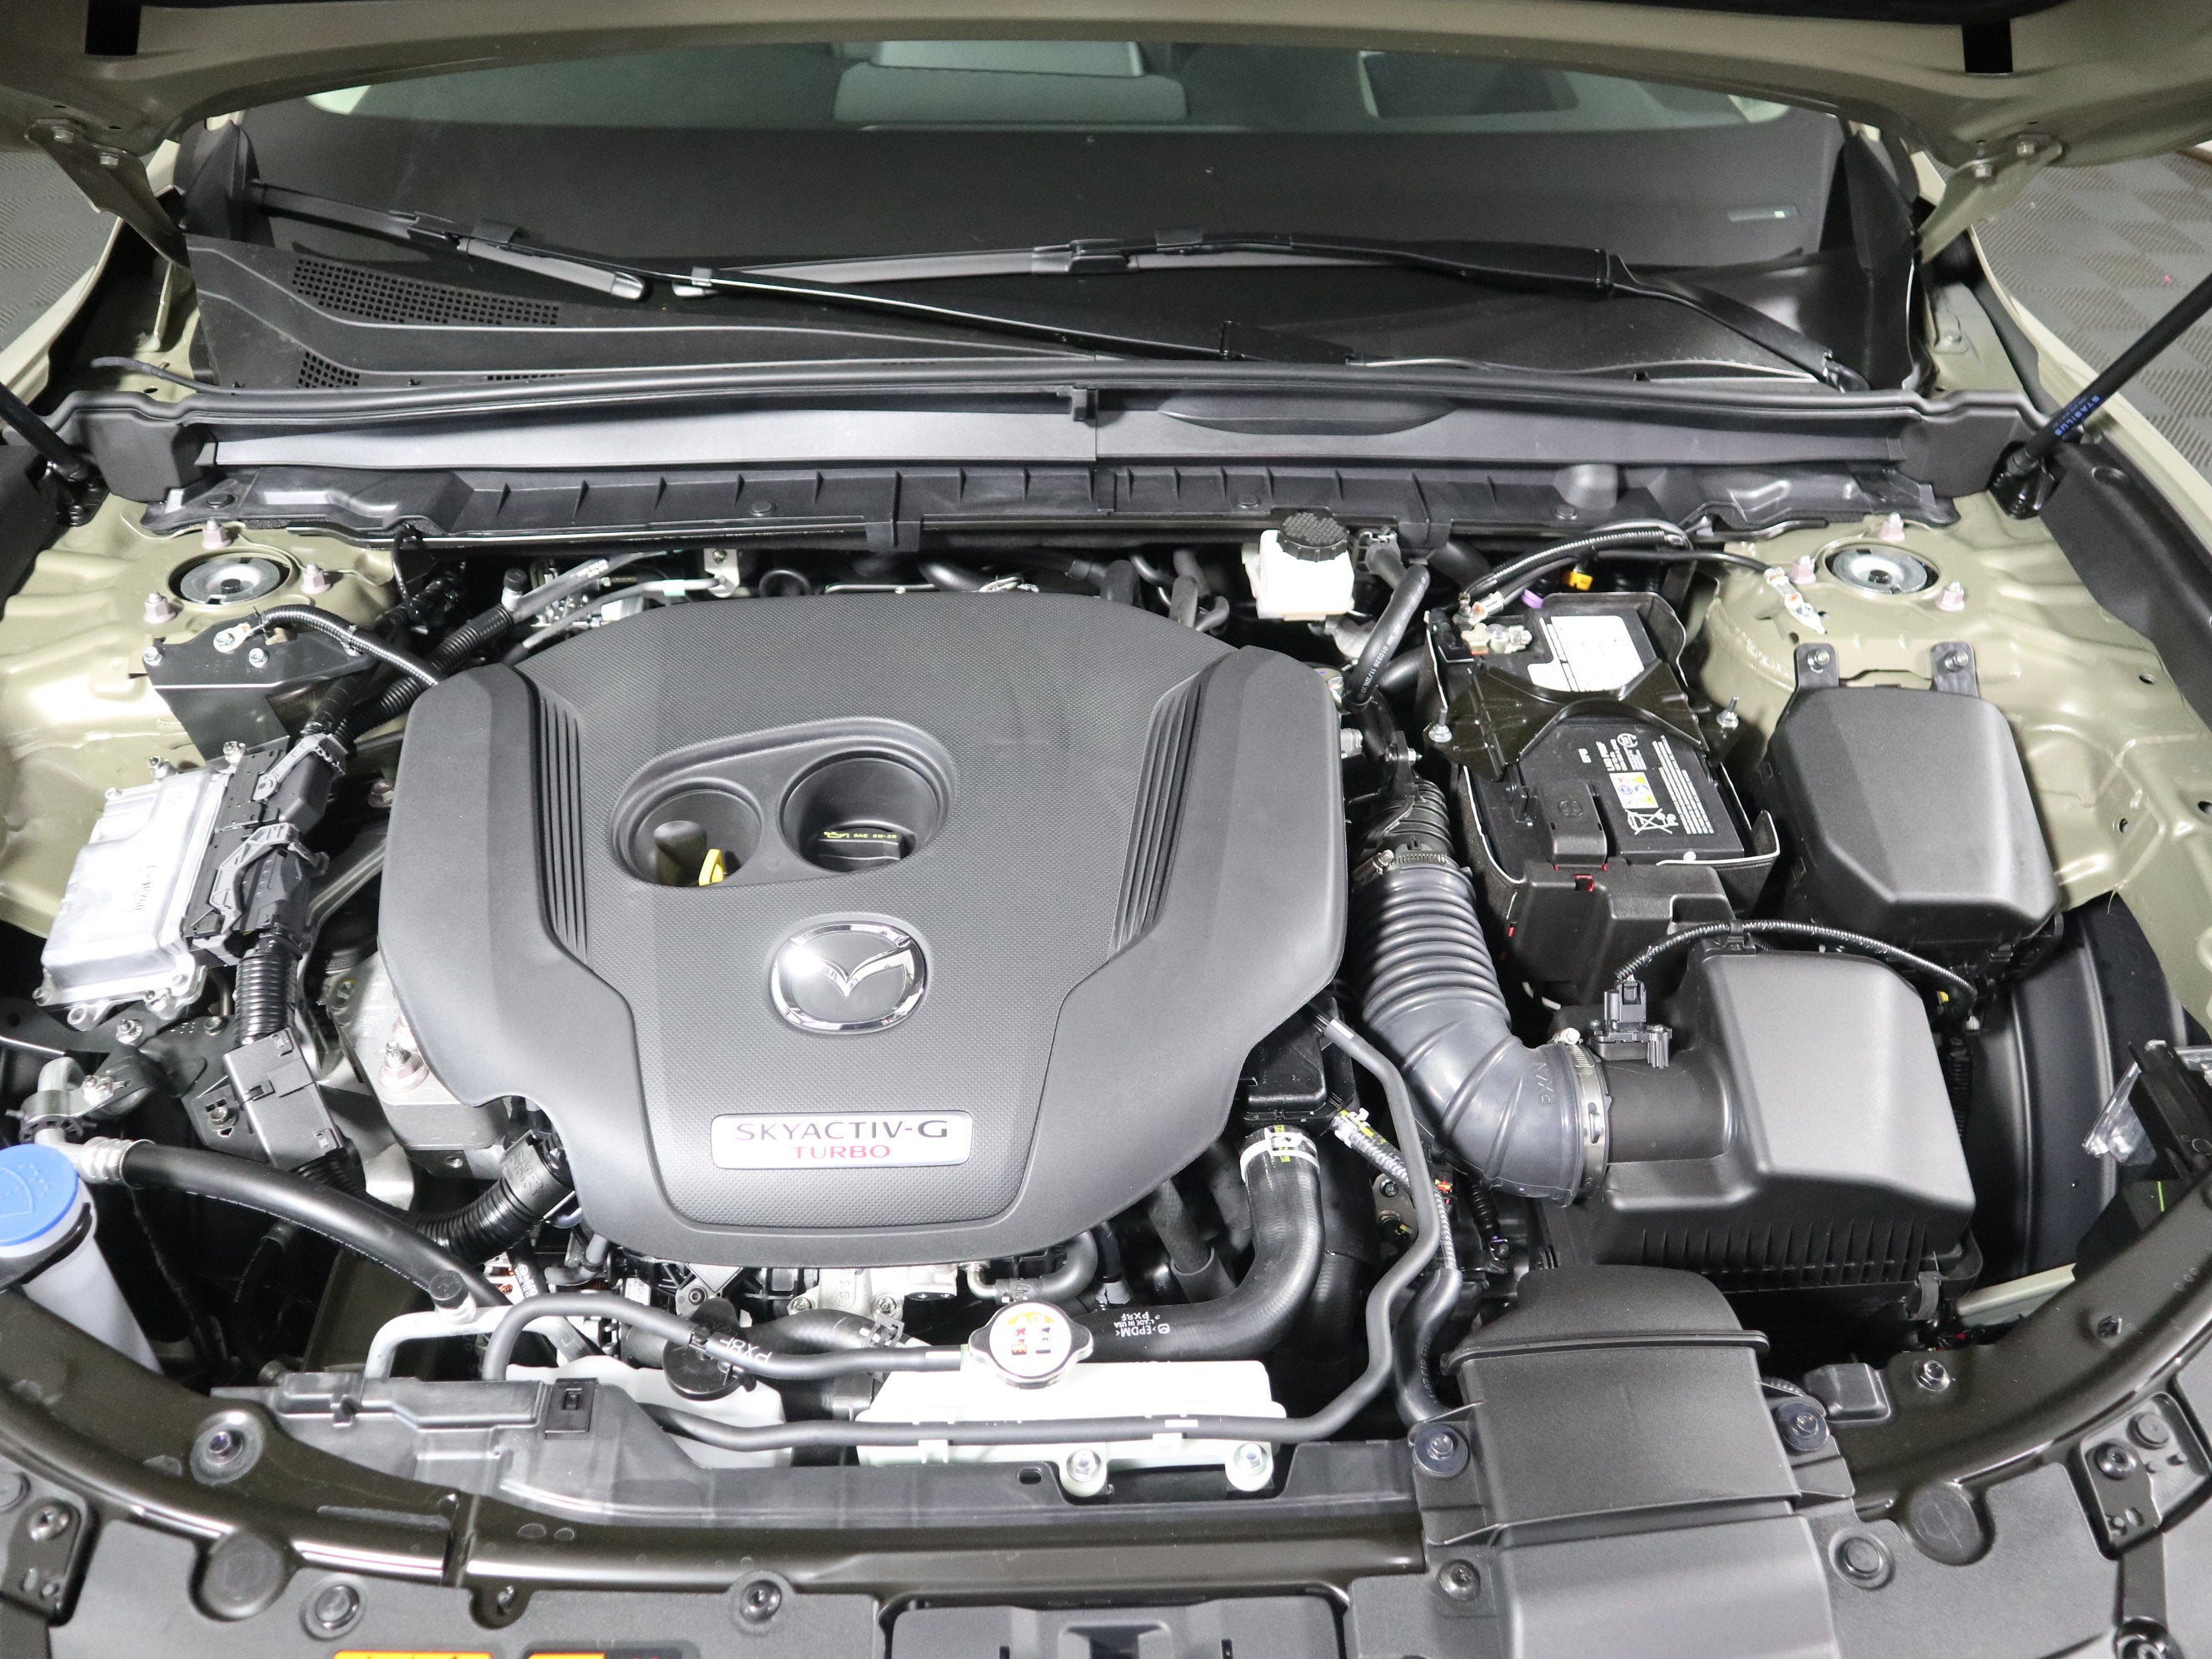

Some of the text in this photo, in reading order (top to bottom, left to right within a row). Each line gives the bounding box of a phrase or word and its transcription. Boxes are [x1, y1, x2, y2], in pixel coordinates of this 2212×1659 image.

[735, 1120, 948, 1141] SKYACTIV-G
[792, 1145, 891, 1159] TURBO
[720, 1338, 773, 1363] PX8F
